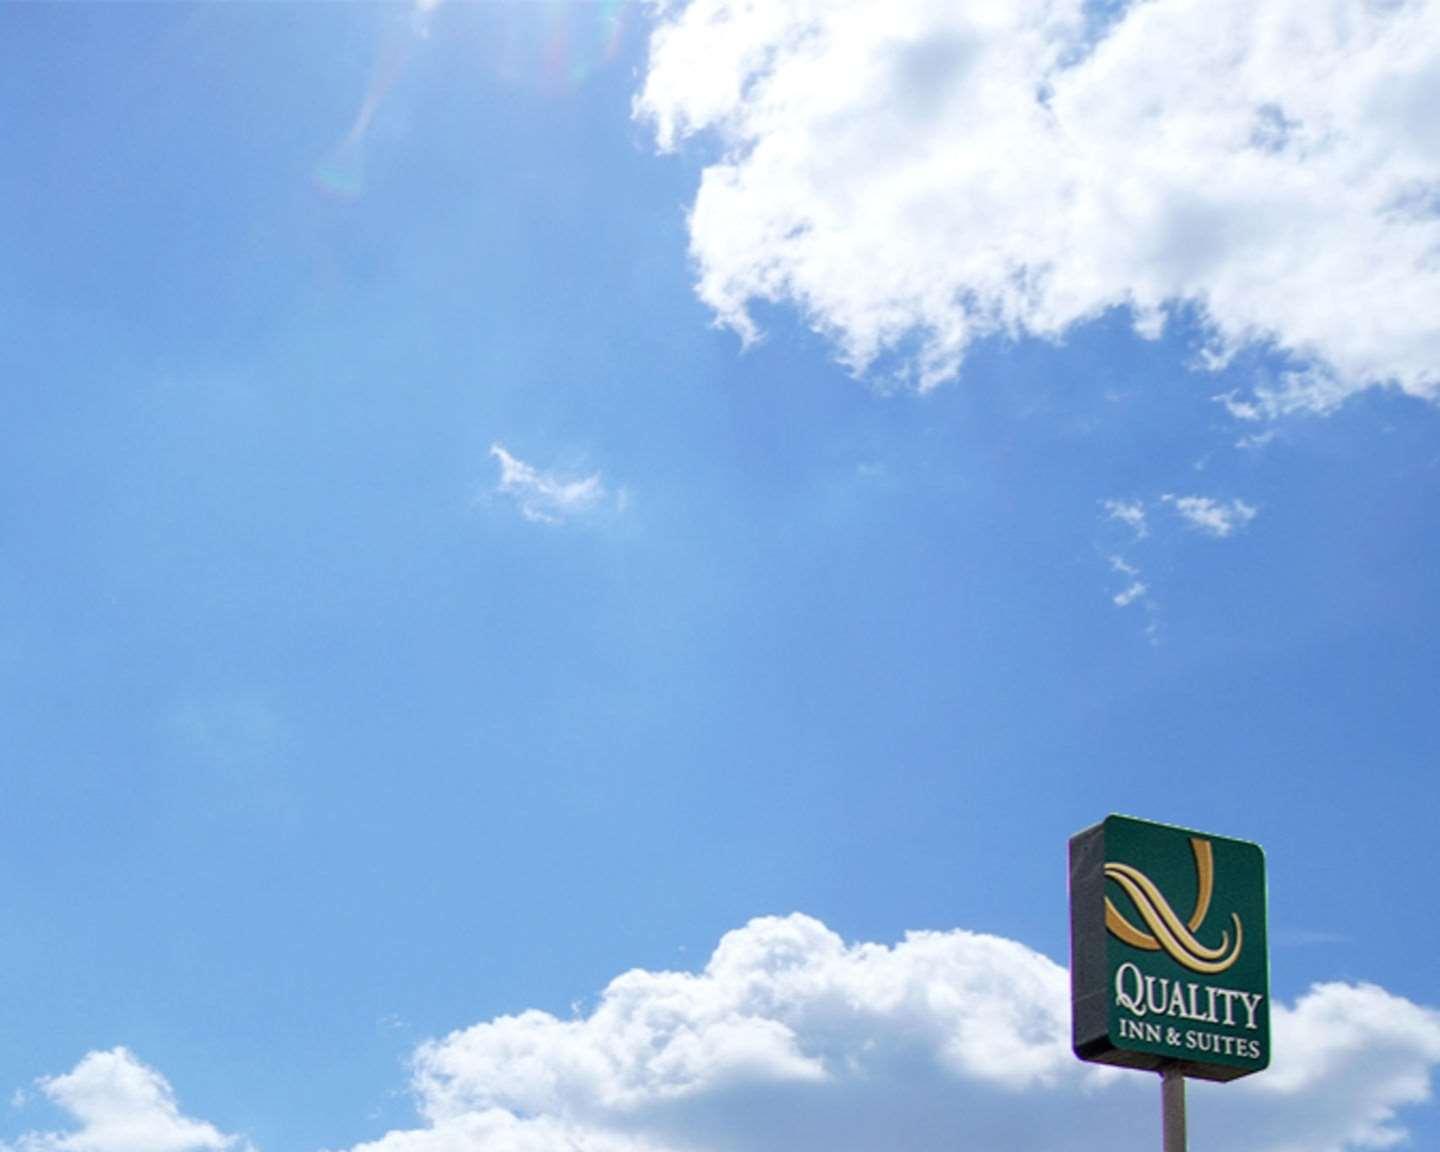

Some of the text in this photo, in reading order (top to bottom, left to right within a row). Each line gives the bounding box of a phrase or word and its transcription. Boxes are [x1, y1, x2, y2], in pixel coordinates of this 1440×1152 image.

[1115, 962, 1263, 1029] QUALITY
[1119, 1018, 1260, 1059] INN & SUITES
